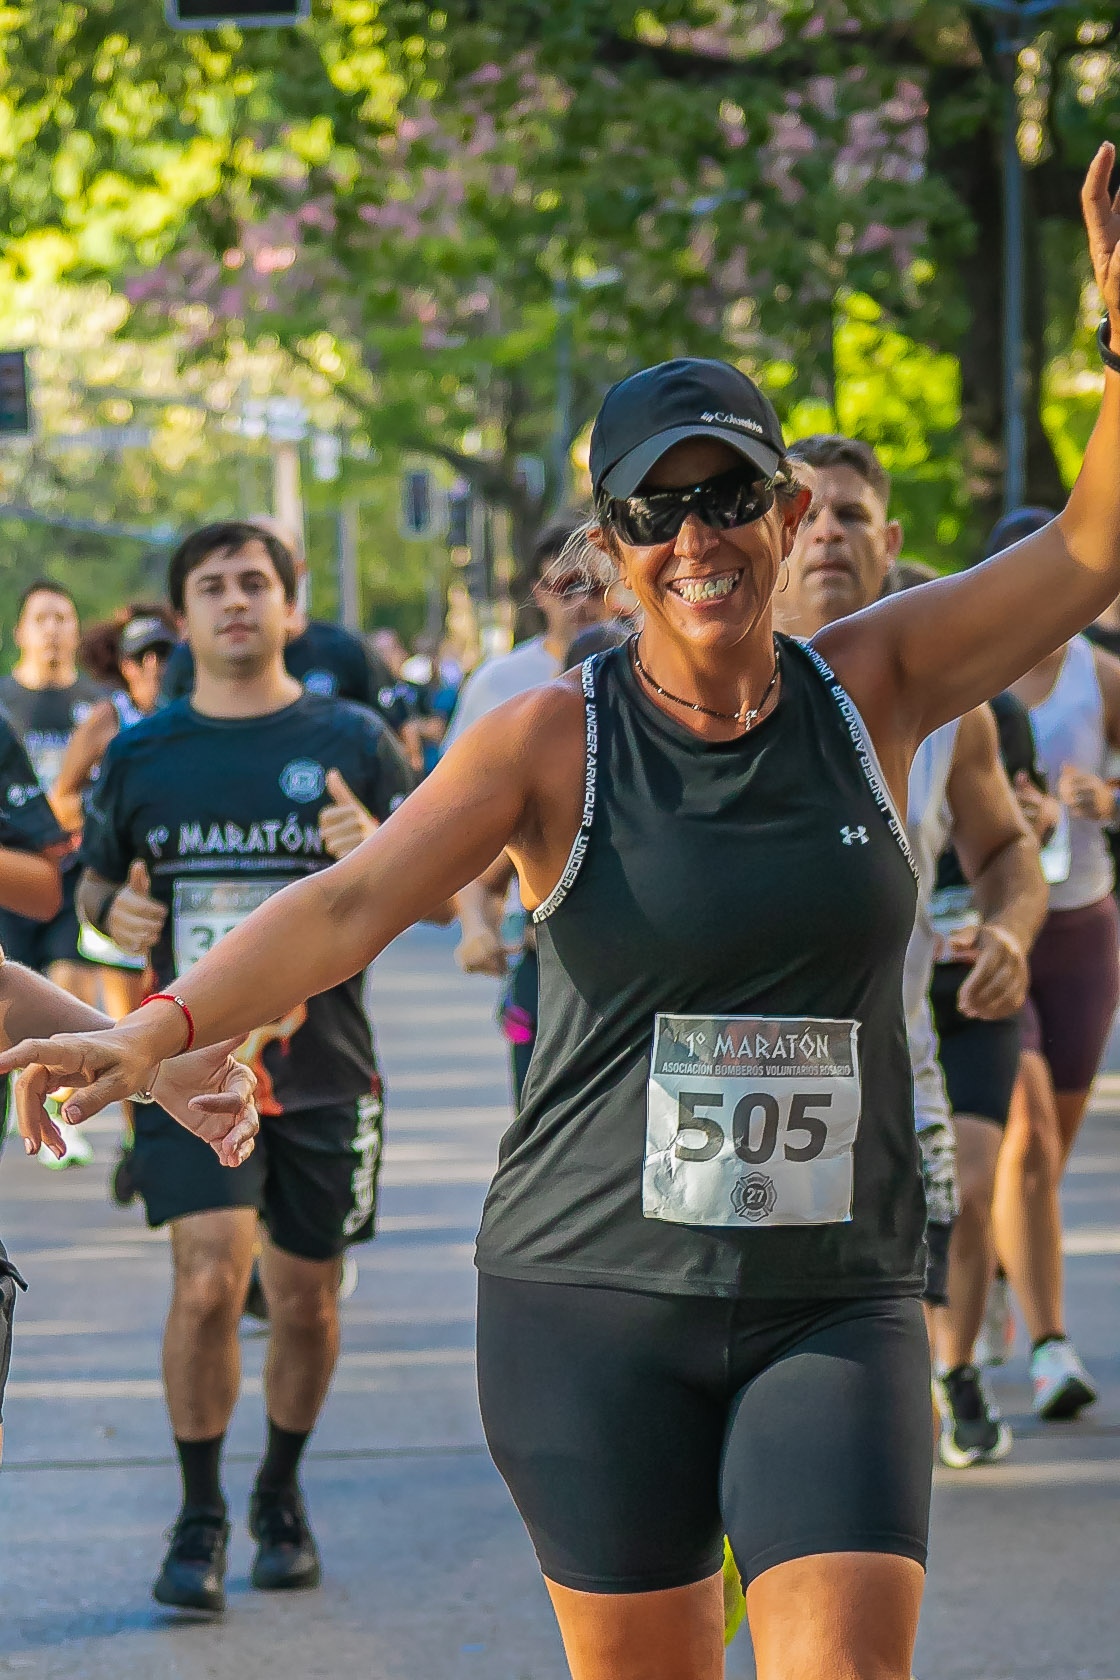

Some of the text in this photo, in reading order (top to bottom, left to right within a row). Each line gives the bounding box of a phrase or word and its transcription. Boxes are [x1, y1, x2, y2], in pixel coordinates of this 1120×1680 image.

[581, 754, 598, 827] ARMOUR
[179, 812, 323, 855] MARATÓN
[563, 834, 590, 889] UNDER
[713, 1026, 829, 1060] MARATÓN
[662, 1061, 713, 1075] ASOCIACIÓN
[714, 1064, 764, 1076] BOMBEROS
[765, 1065, 819, 1076] VOLUNTARIOS
[674, 1091, 834, 1165] 505
[746, 1187, 765, 1204] 27
